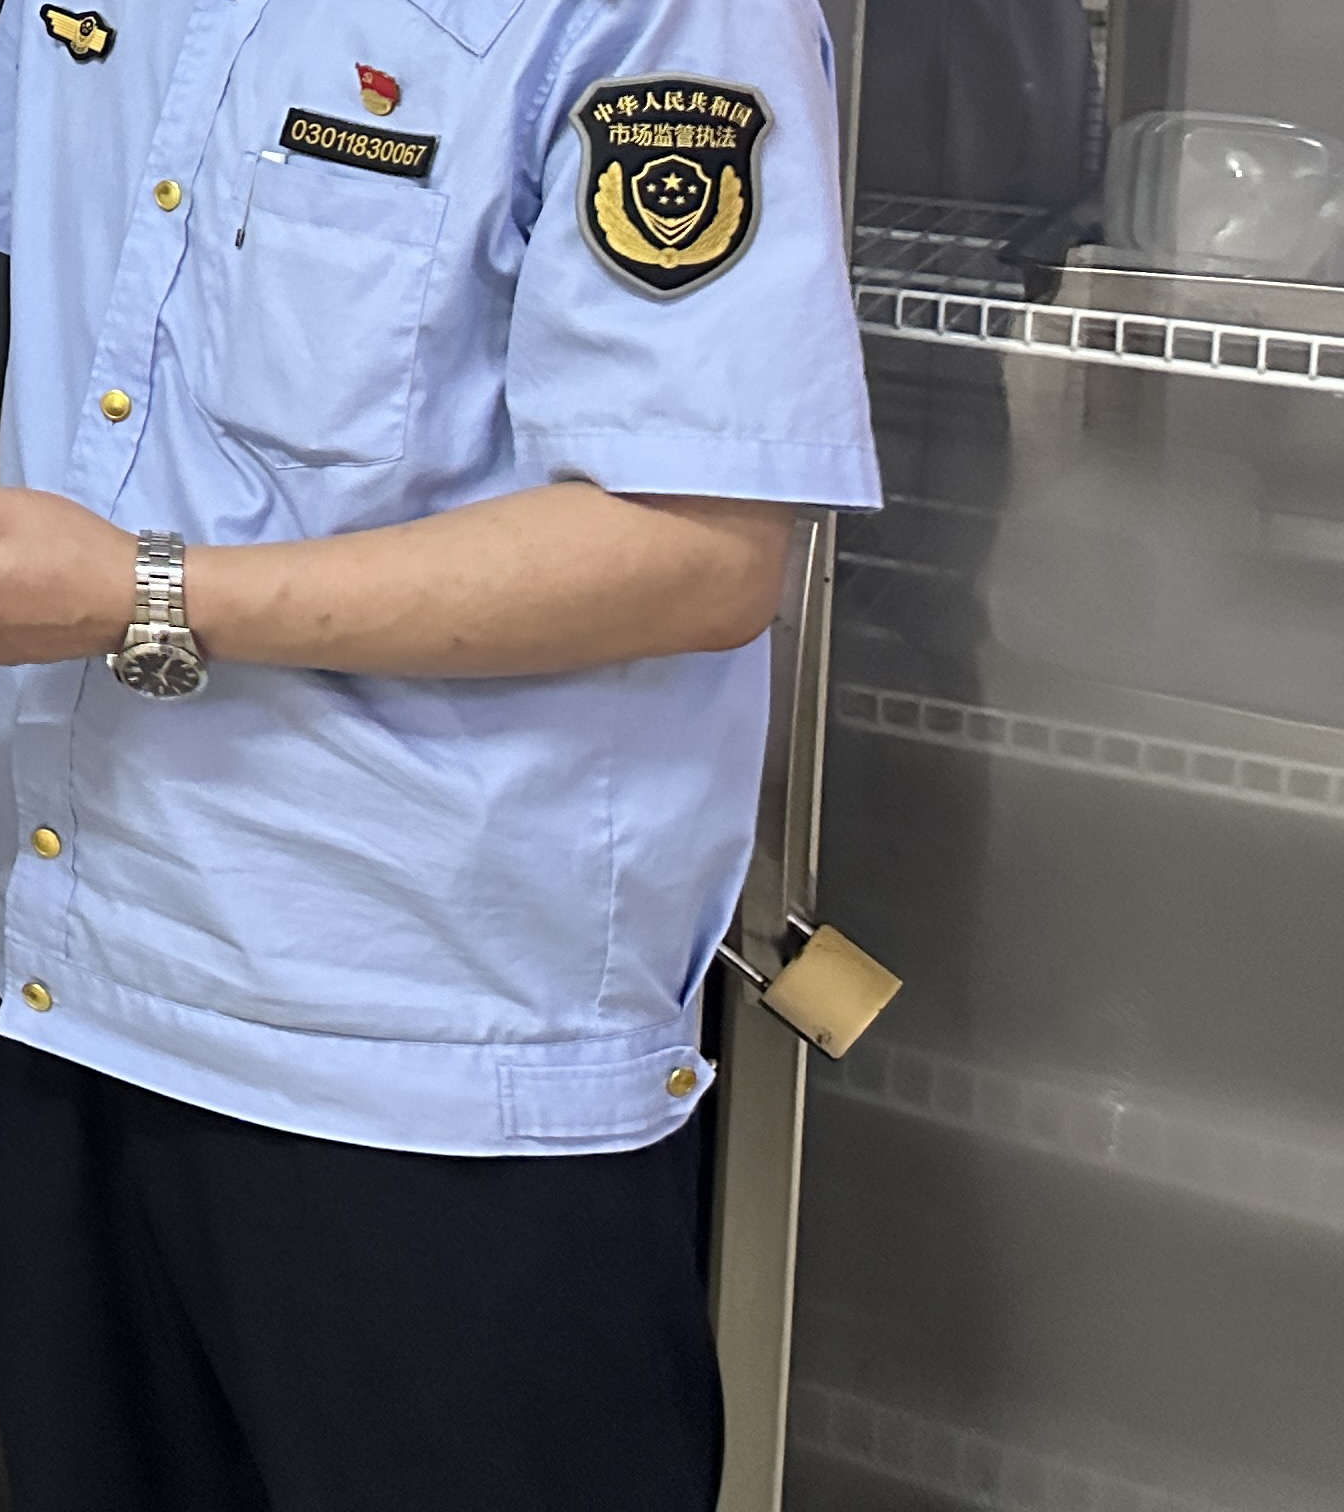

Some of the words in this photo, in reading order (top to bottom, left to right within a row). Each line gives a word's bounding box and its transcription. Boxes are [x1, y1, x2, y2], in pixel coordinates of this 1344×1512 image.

[593, 90, 753, 128] 中华人民共和国
[290, 120, 427, 168] 03011830067
[608, 122, 737, 148] 市场监管执法
